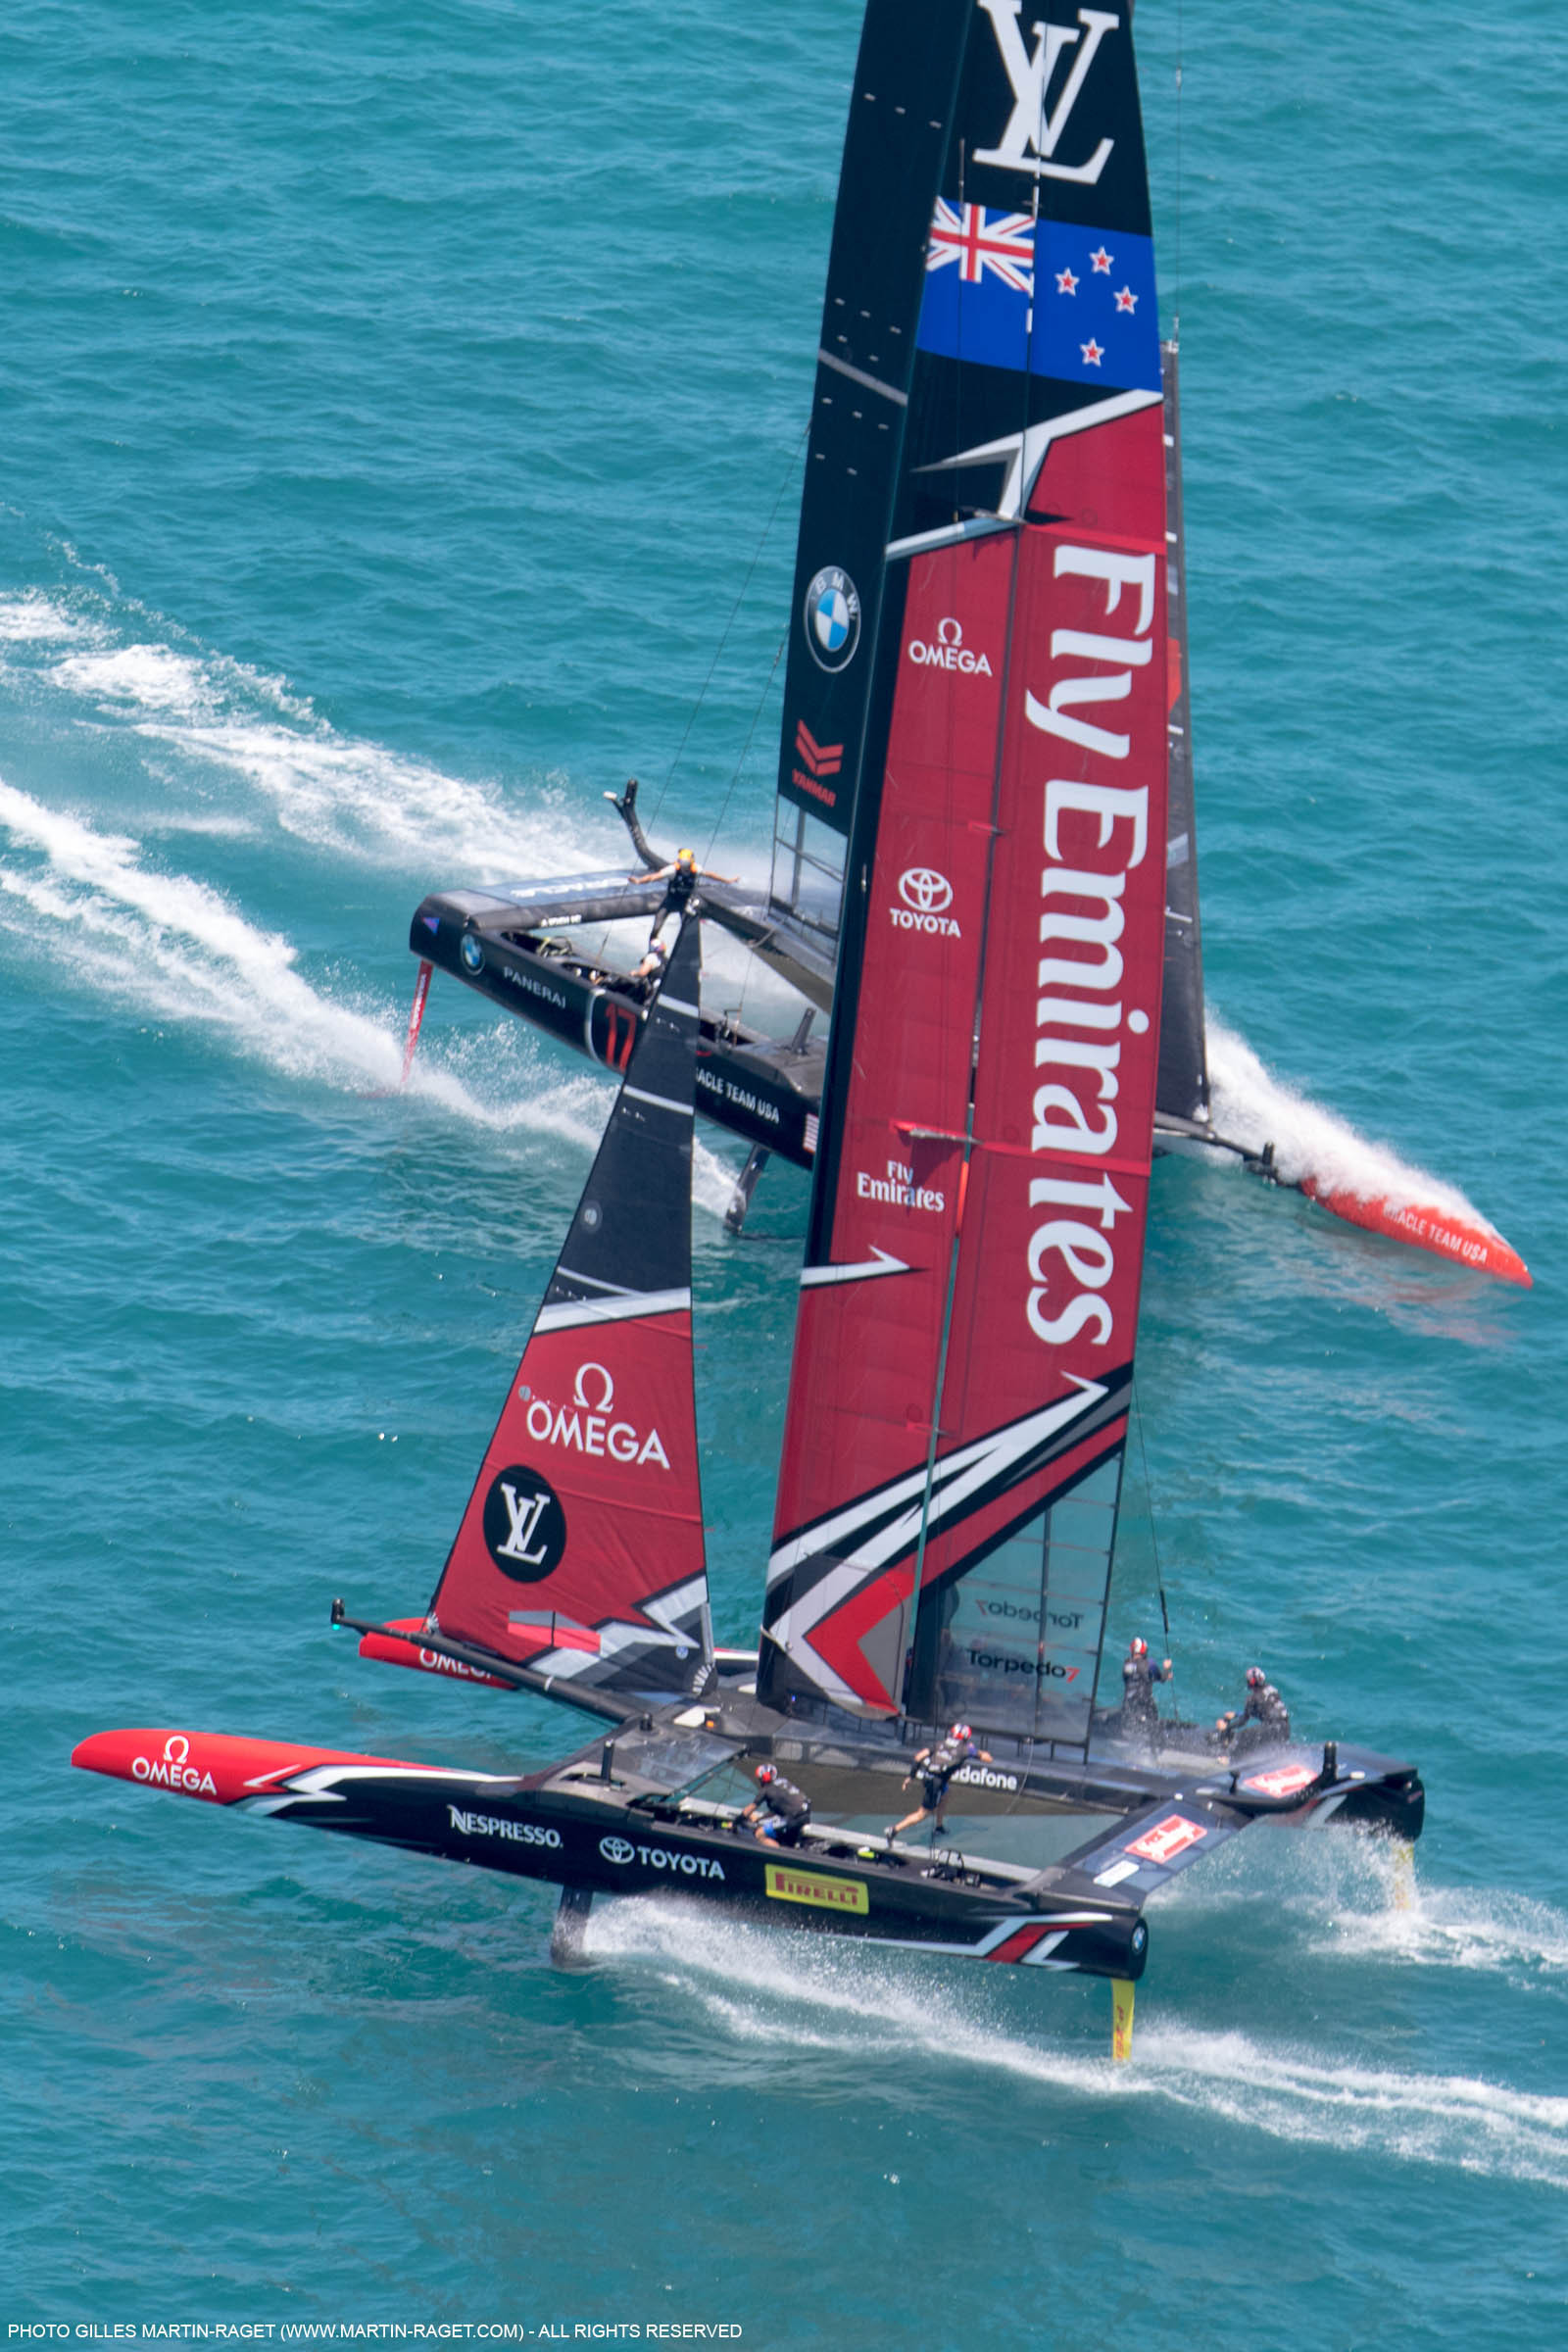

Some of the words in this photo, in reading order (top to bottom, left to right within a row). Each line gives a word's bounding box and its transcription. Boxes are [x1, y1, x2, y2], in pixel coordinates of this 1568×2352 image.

[908, 639, 993, 677] OMEGA
[1025, 544, 1156, 760] Fly
[792, 767, 837, 808] YANMAR
[889, 906, 961, 938] TOYOTA
[504, 965, 567, 1008] PANERAI
[606, 1003, 637, 1075] 17
[1026, 779, 1150, 1346] Emirates
[696, 1067, 724, 1094] ACLE
[725, 1081, 759, 1112] TEAM
[757, 1100, 780, 1124] USA
[857, 1171, 945, 1212] Emirates
[887, 1159, 914, 1185] Fly
[1429, 1223, 1462, 1251] TEAM
[1462, 1240, 1488, 1263] USA
[526, 1400, 670, 1470] OMEGA
[419, 1647, 491, 1680] OME
[965, 1647, 1081, 1684] Torpedo7
[131, 1756, 218, 1796] OMEGA
[950, 1764, 1018, 1791] odafone
[447, 1804, 564, 1848] NESPRESSO
[637, 1845, 726, 1881] TOYOTA
[774, 1872, 859, 1906] PIRELLI
